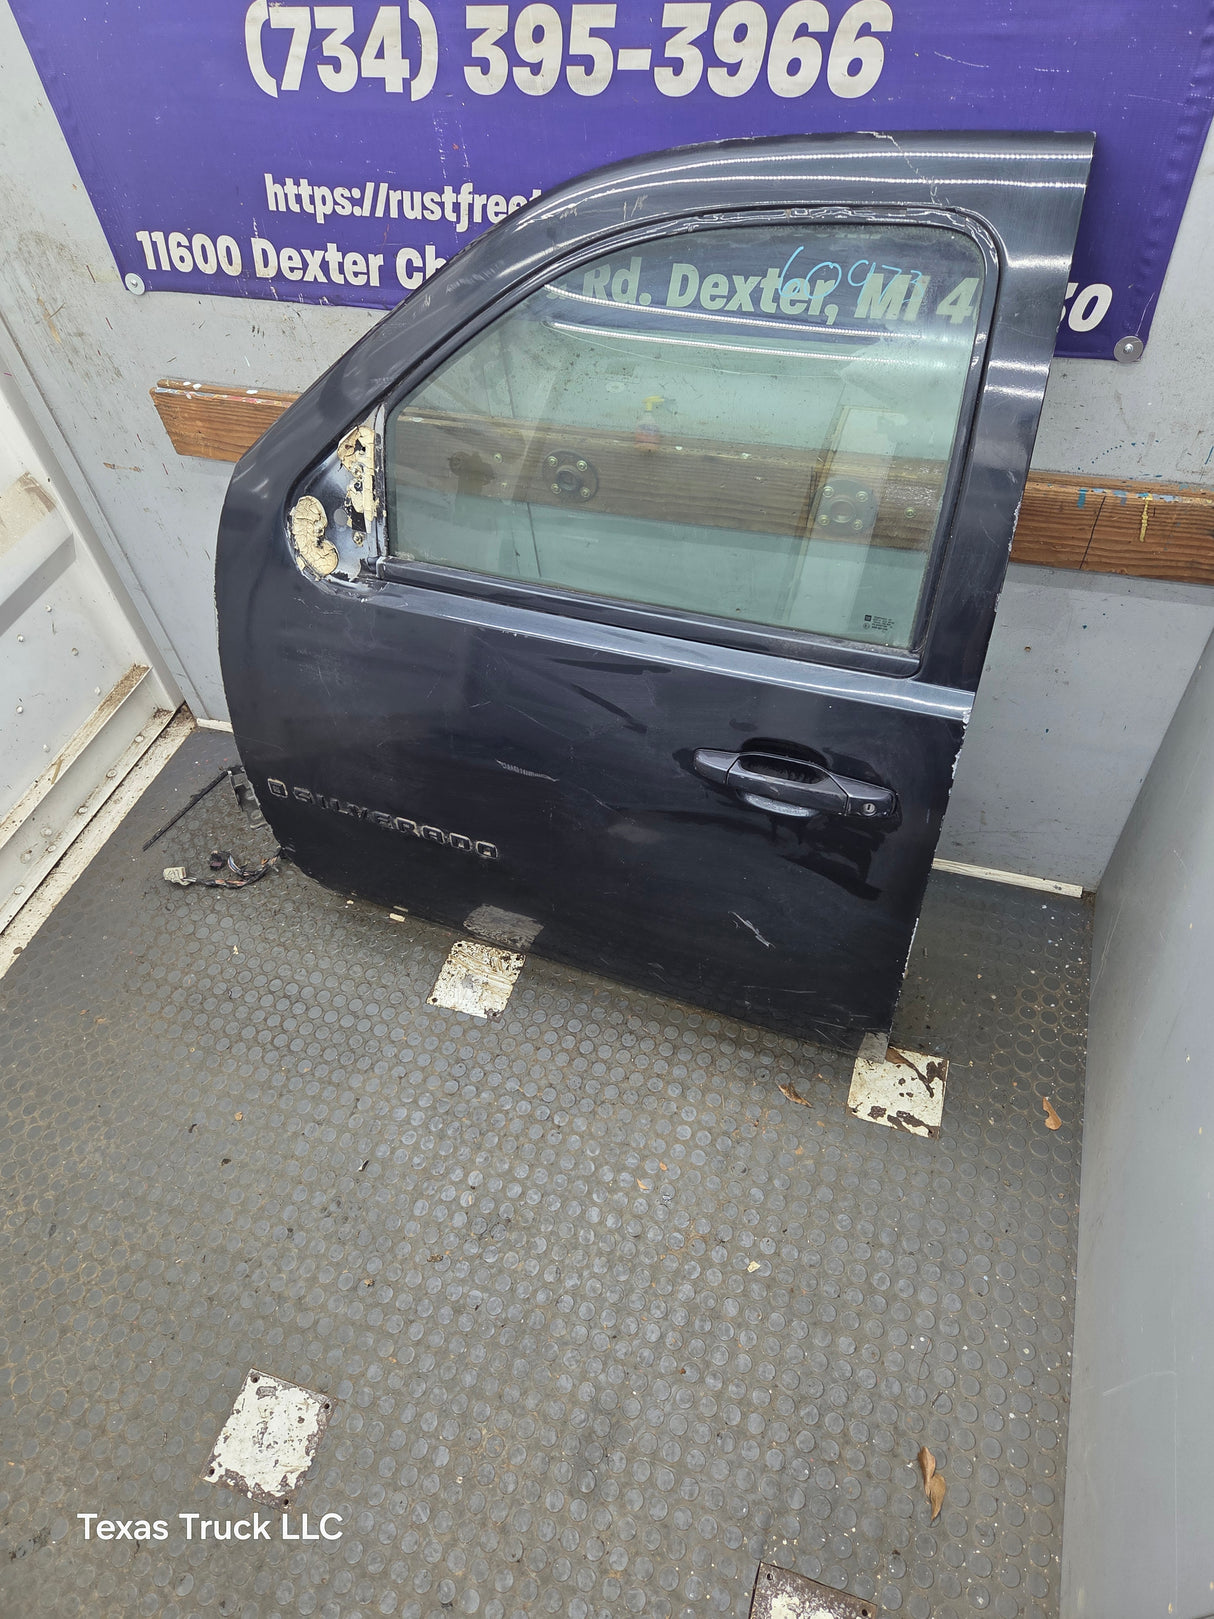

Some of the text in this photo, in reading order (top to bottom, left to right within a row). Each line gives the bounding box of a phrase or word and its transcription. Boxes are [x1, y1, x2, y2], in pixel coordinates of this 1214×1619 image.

[244, 0, 893, 102] (734) 395-3966
[264, 173, 542, 233] https://rustfree
[136, 230, 242, 277] 11600
[250, 238, 384, 288] Dexter
[582, 256, 652, 306] Rd.
[666, 263, 839, 326] Dexter,
[854, 273, 931, 322] MI
